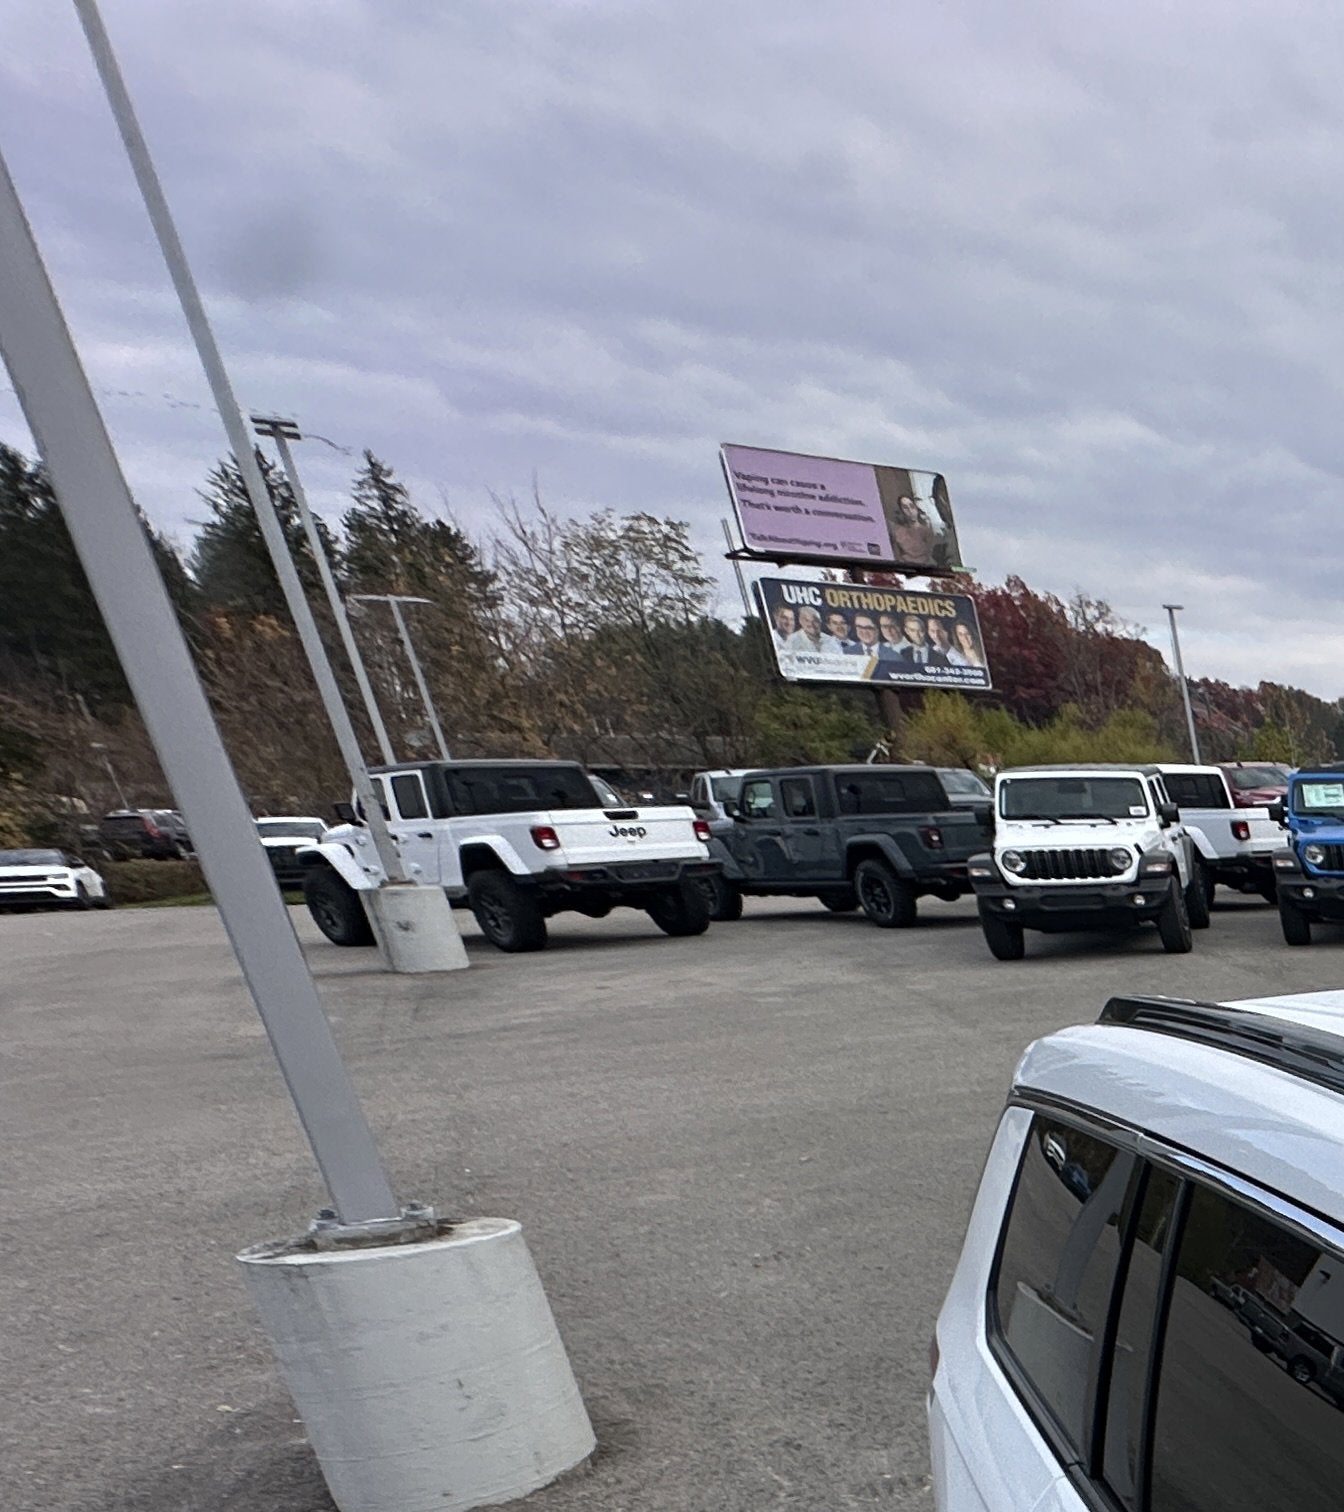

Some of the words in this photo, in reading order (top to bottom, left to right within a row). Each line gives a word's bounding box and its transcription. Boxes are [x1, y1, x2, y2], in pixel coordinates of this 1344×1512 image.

[782, 583, 822, 605] UHC
[825, 588, 956, 617] ORTHOPAEDICS
[607, 823, 647, 839] Jeep
